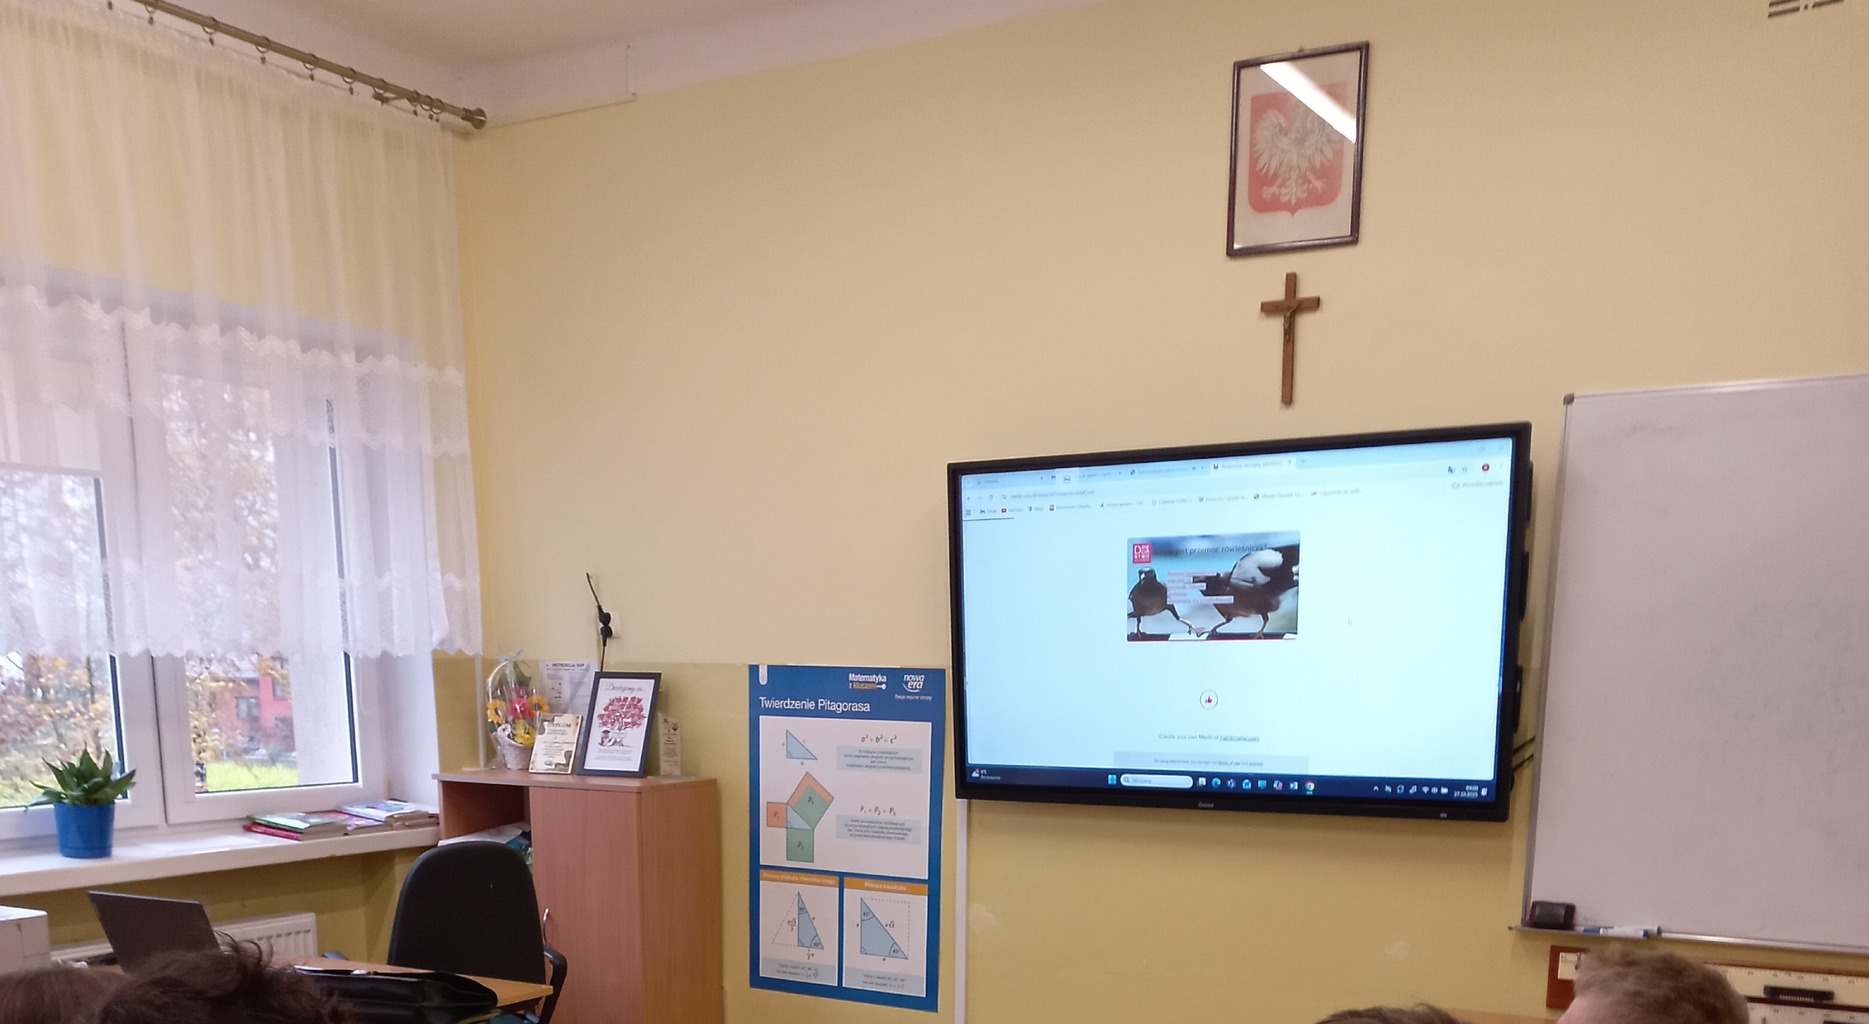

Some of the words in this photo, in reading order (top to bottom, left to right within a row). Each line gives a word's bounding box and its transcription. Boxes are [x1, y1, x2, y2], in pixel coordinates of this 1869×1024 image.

[848, 673, 887, 683] Matematyka
[903, 674, 925, 682] nowa
[907, 681, 923, 689] era
[759, 697, 815, 710] Twierdzenie
[818, 698, 870, 714] Pitagorasa
